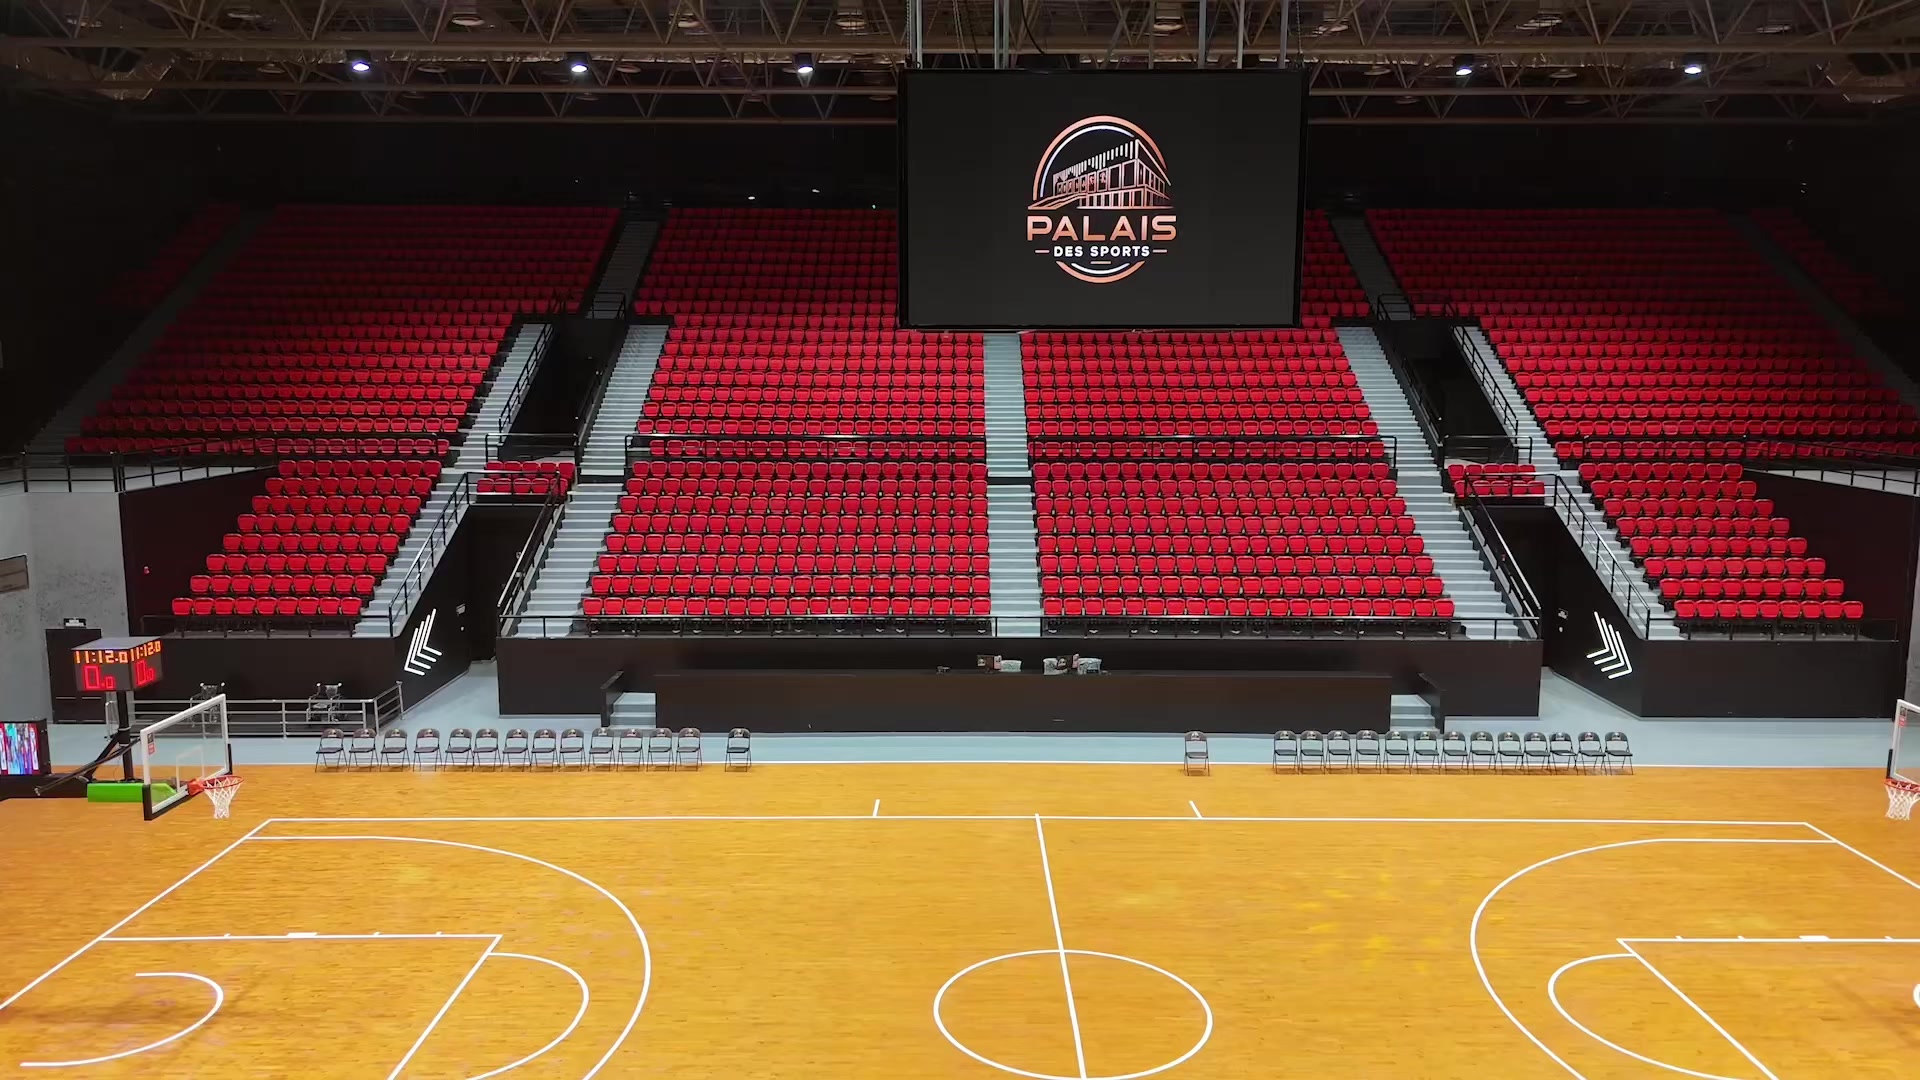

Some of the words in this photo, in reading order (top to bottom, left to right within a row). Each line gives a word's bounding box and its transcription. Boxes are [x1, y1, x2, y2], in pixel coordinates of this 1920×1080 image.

[1027, 215, 1177, 241] PALAIS
[1053, 245, 1083, 257] DES
[1090, 245, 1150, 257] SPORTS
